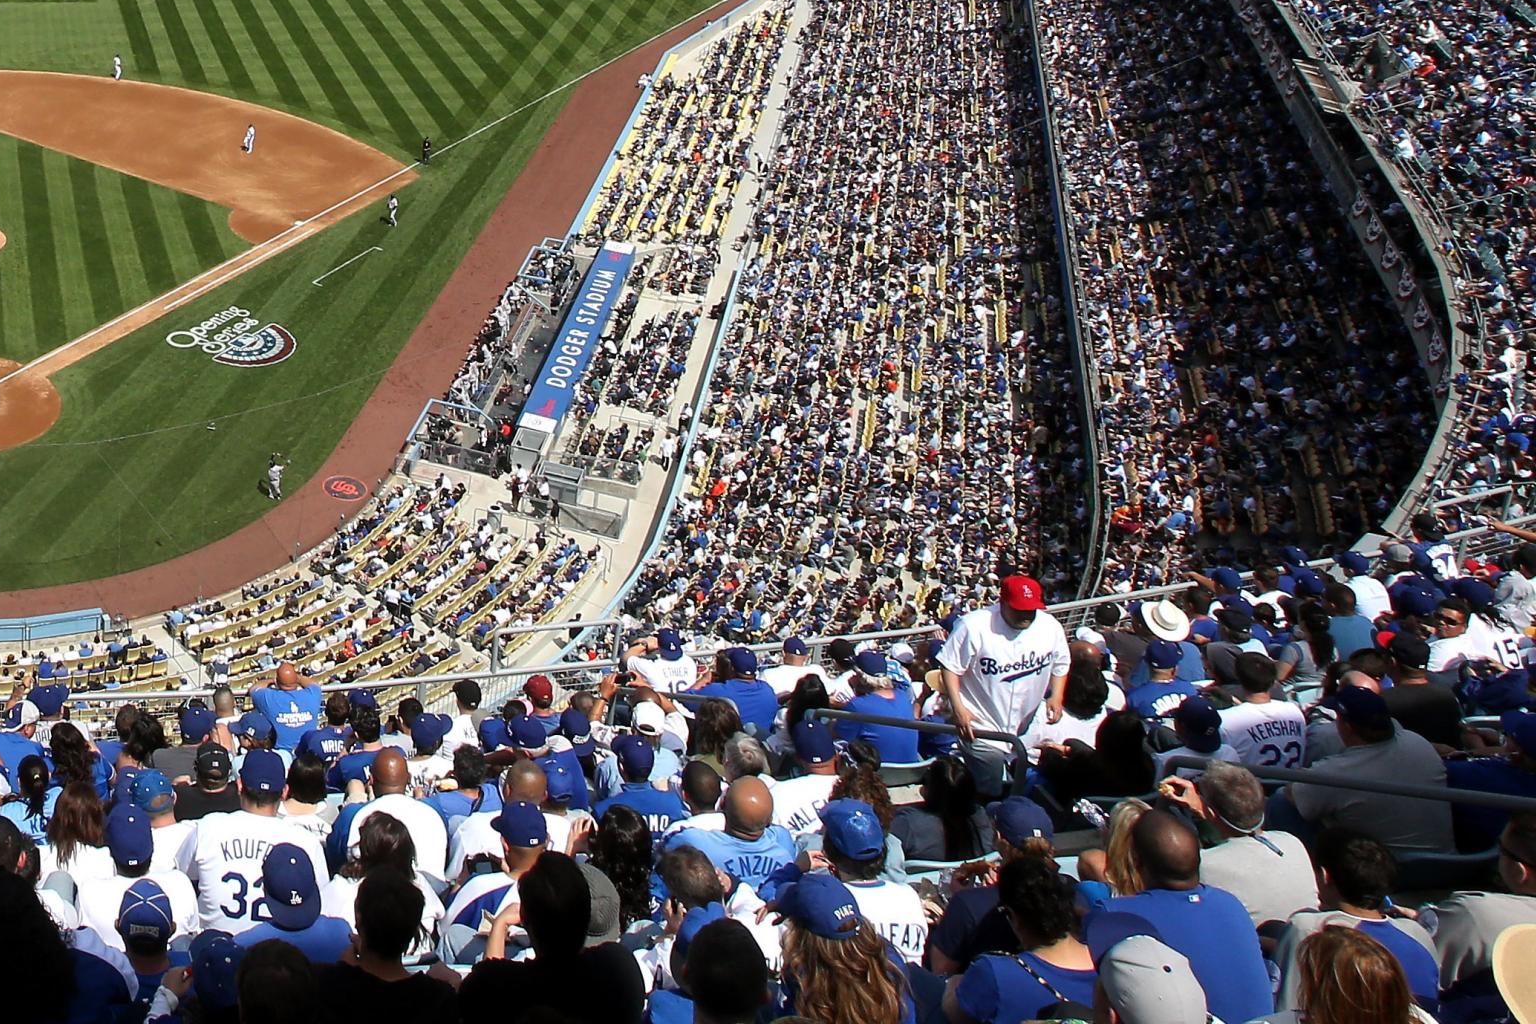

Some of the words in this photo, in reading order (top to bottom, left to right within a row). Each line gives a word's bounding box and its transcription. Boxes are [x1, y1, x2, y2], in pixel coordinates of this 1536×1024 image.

[166, 306, 250, 348] Opening
[202, 317, 259, 354] Series
[546, 328, 590, 389] DODGER
[576, 270, 616, 326] STADIUM
[662, 667, 688, 676] ETHIER
[1246, 720, 1302, 743] KERSHAW
